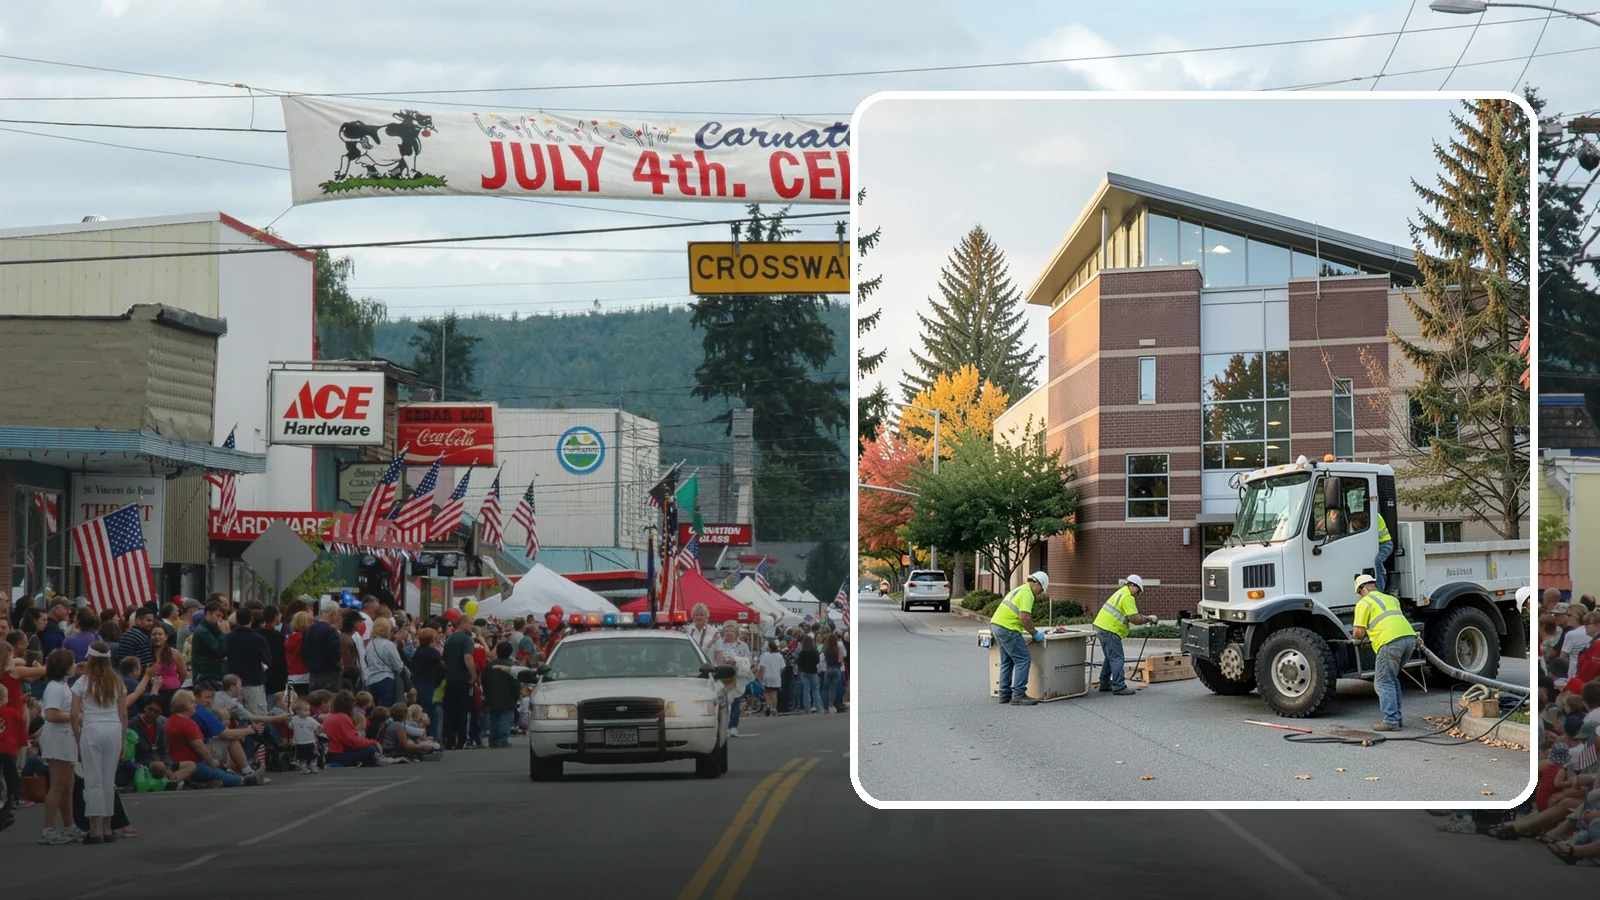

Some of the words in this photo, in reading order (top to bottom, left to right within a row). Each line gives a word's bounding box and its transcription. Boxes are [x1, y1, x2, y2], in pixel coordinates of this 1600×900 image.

[481, 140, 605, 193] JULY
[632, 150, 746, 198] 4th.
[696, 254, 850, 280] CROSSWA
[282, 380, 374, 420] ACE
[406, 409, 452, 422] CEDAR
[461, 409, 485, 422] LOG
[283, 421, 371, 437] Hardware
[416, 428, 477, 447] Coca-Cola
[353, 467, 386, 481] Simpl
[95, 485, 124, 495] Vincent
[126, 486, 135, 495] de
[137, 486, 155, 496] Paul
[688, 526, 741, 535] CRNATION
[699, 535, 730, 544] GLASS
